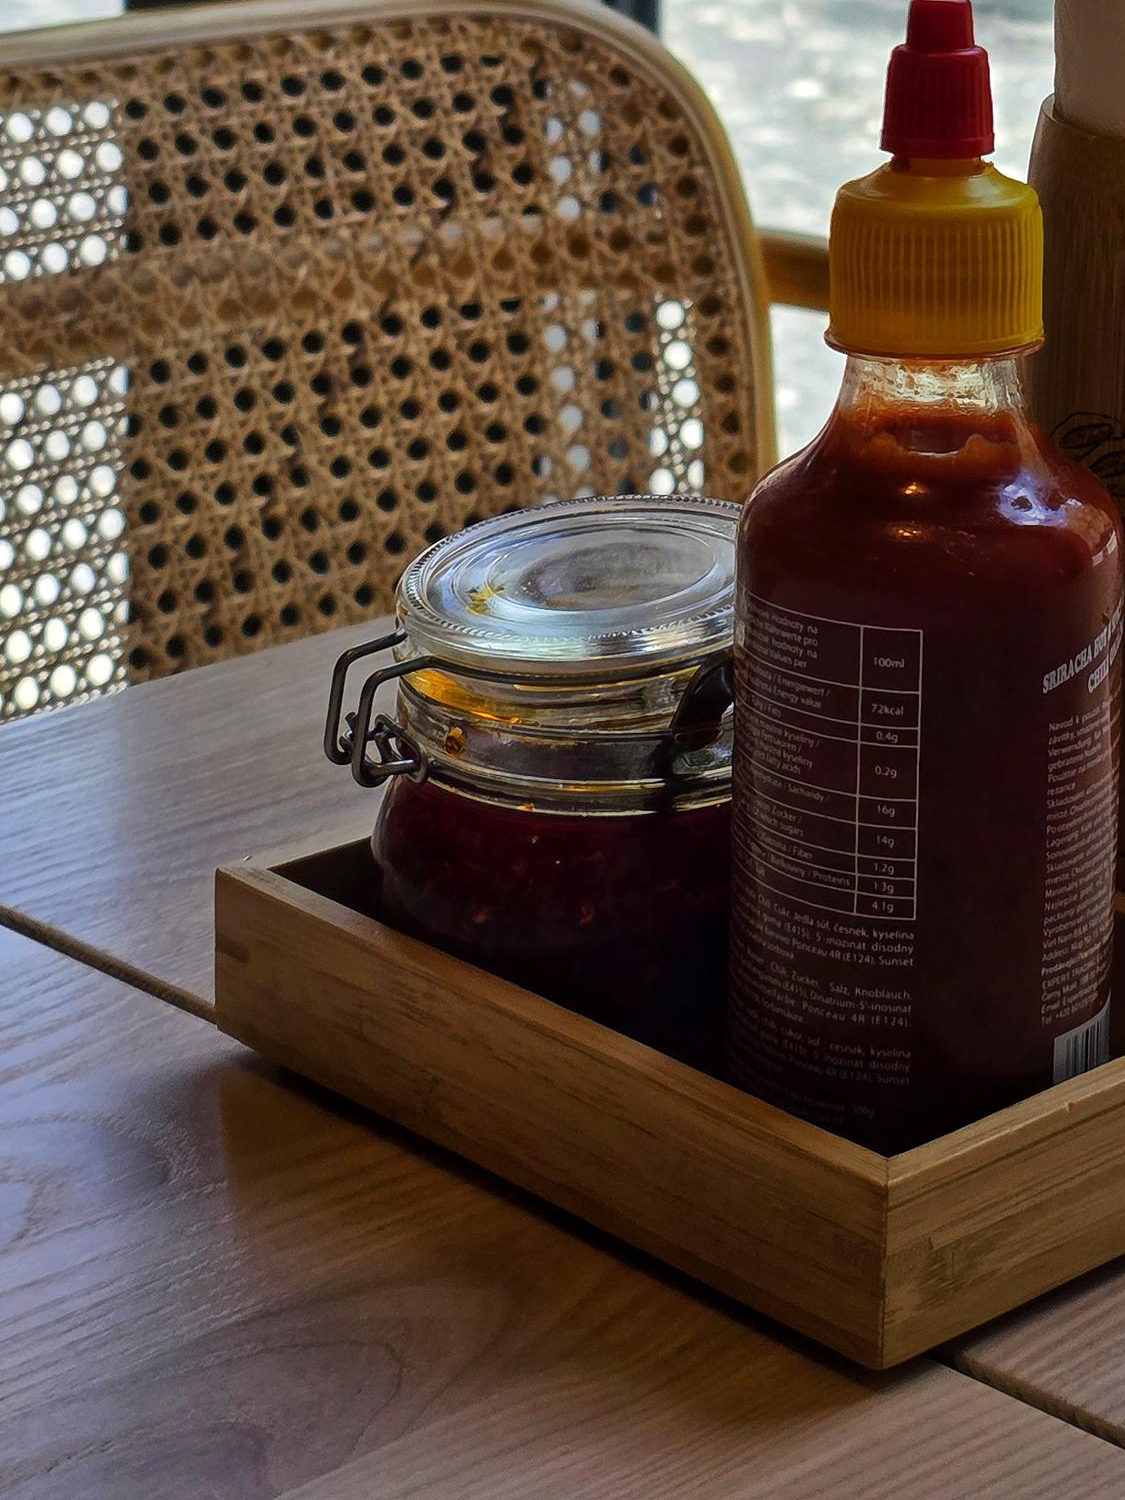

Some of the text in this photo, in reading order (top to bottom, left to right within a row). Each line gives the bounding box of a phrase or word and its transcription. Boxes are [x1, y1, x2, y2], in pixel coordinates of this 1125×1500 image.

[873, 656, 904, 668] 100ml
[1042, 644, 1093, 694] SRIRACHA
[871, 703, 903, 715] 72kcal
[876, 731, 898, 743] 0.4g
[874, 766, 897, 779] 0.2g
[876, 804, 895, 817] 16g
[876, 835, 894, 848] 14g
[873, 862, 894, 875] 1.2g
[813, 870, 849, 886] Proteins
[871, 900, 893, 913] 4.1g
[872, 929, 914, 941] kyselina
[871, 941, 913, 954] disodný
[878, 956, 913, 966] Sunset
